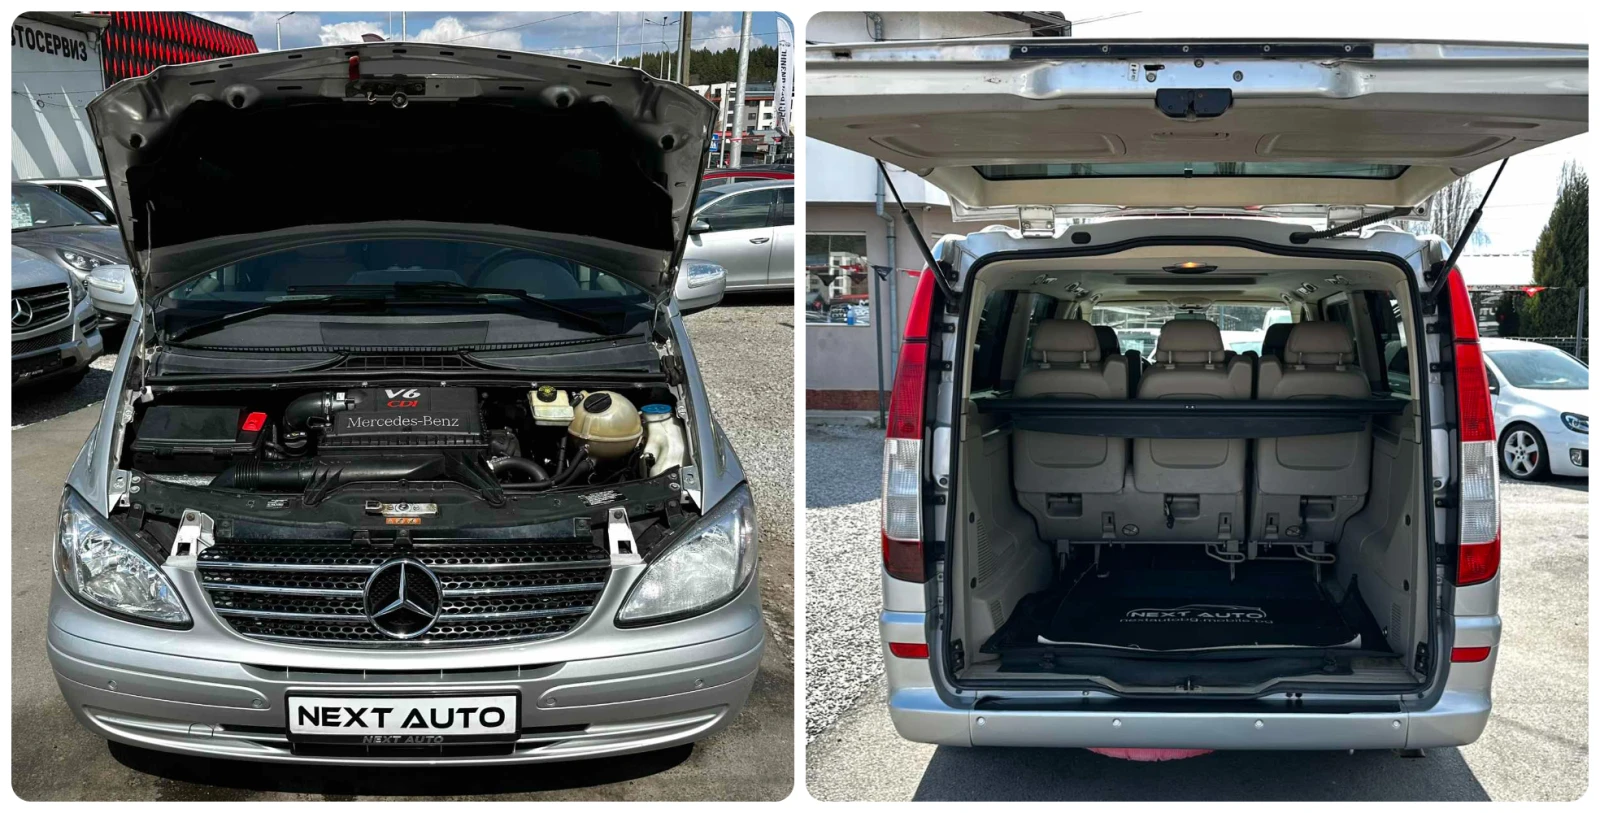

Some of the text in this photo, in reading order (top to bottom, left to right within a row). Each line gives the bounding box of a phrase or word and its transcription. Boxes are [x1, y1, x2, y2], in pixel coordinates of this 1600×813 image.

[385, 388, 421, 399] V6
[387, 400, 419, 408] CDI
[347, 415, 460, 429] Mercedes-Benz
[298, 706, 506, 729] NEXT AUTO
[362, 735, 444, 744] NEXT AUTO
